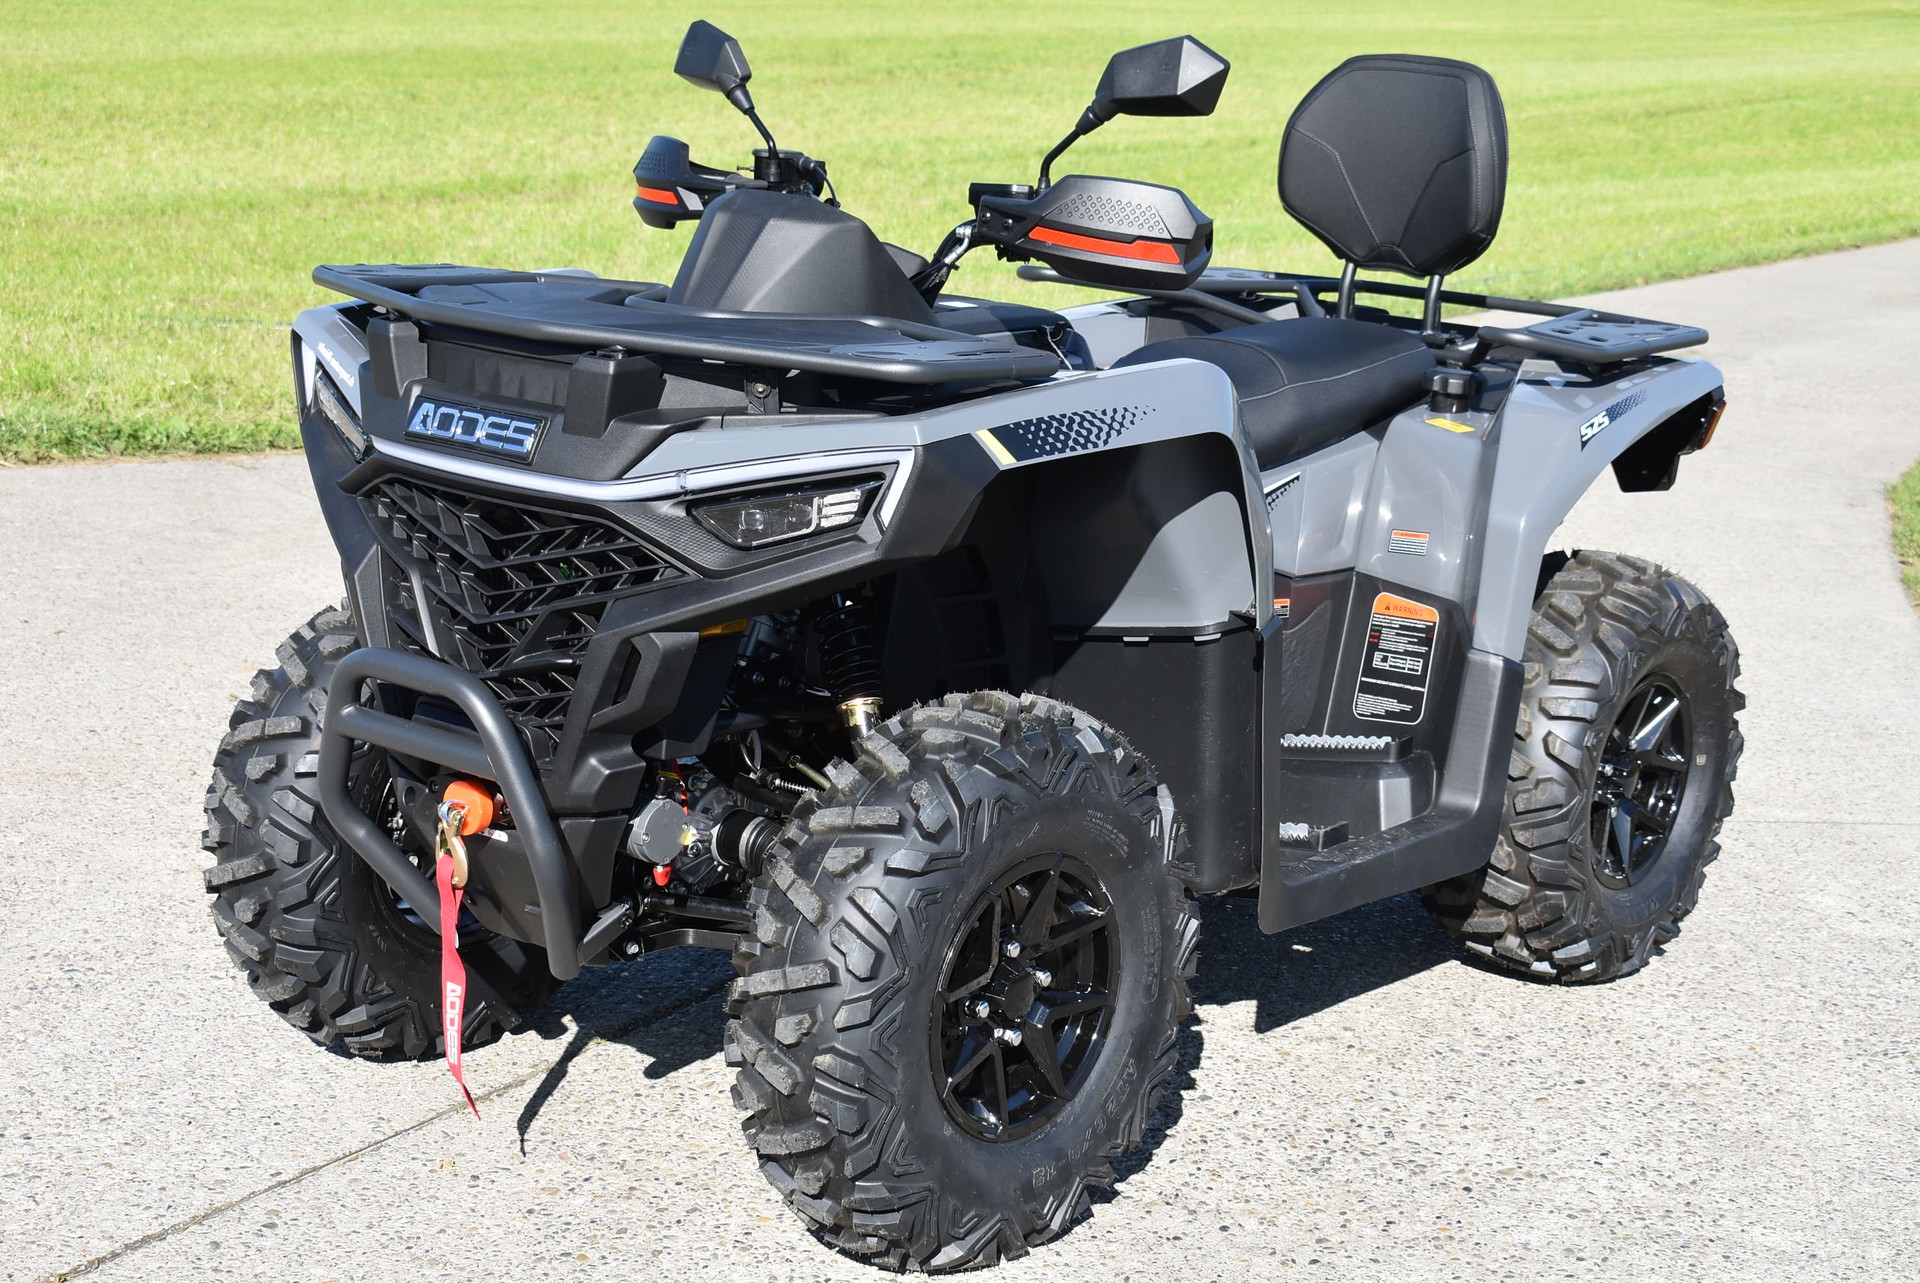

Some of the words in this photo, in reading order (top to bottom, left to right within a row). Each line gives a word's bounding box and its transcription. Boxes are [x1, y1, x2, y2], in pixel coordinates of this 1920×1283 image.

[408, 402, 537, 453] AODES
[1579, 410, 1610, 442] 525
[1392, 604, 1424, 617] WARNING
[446, 981, 462, 1065] AODES
